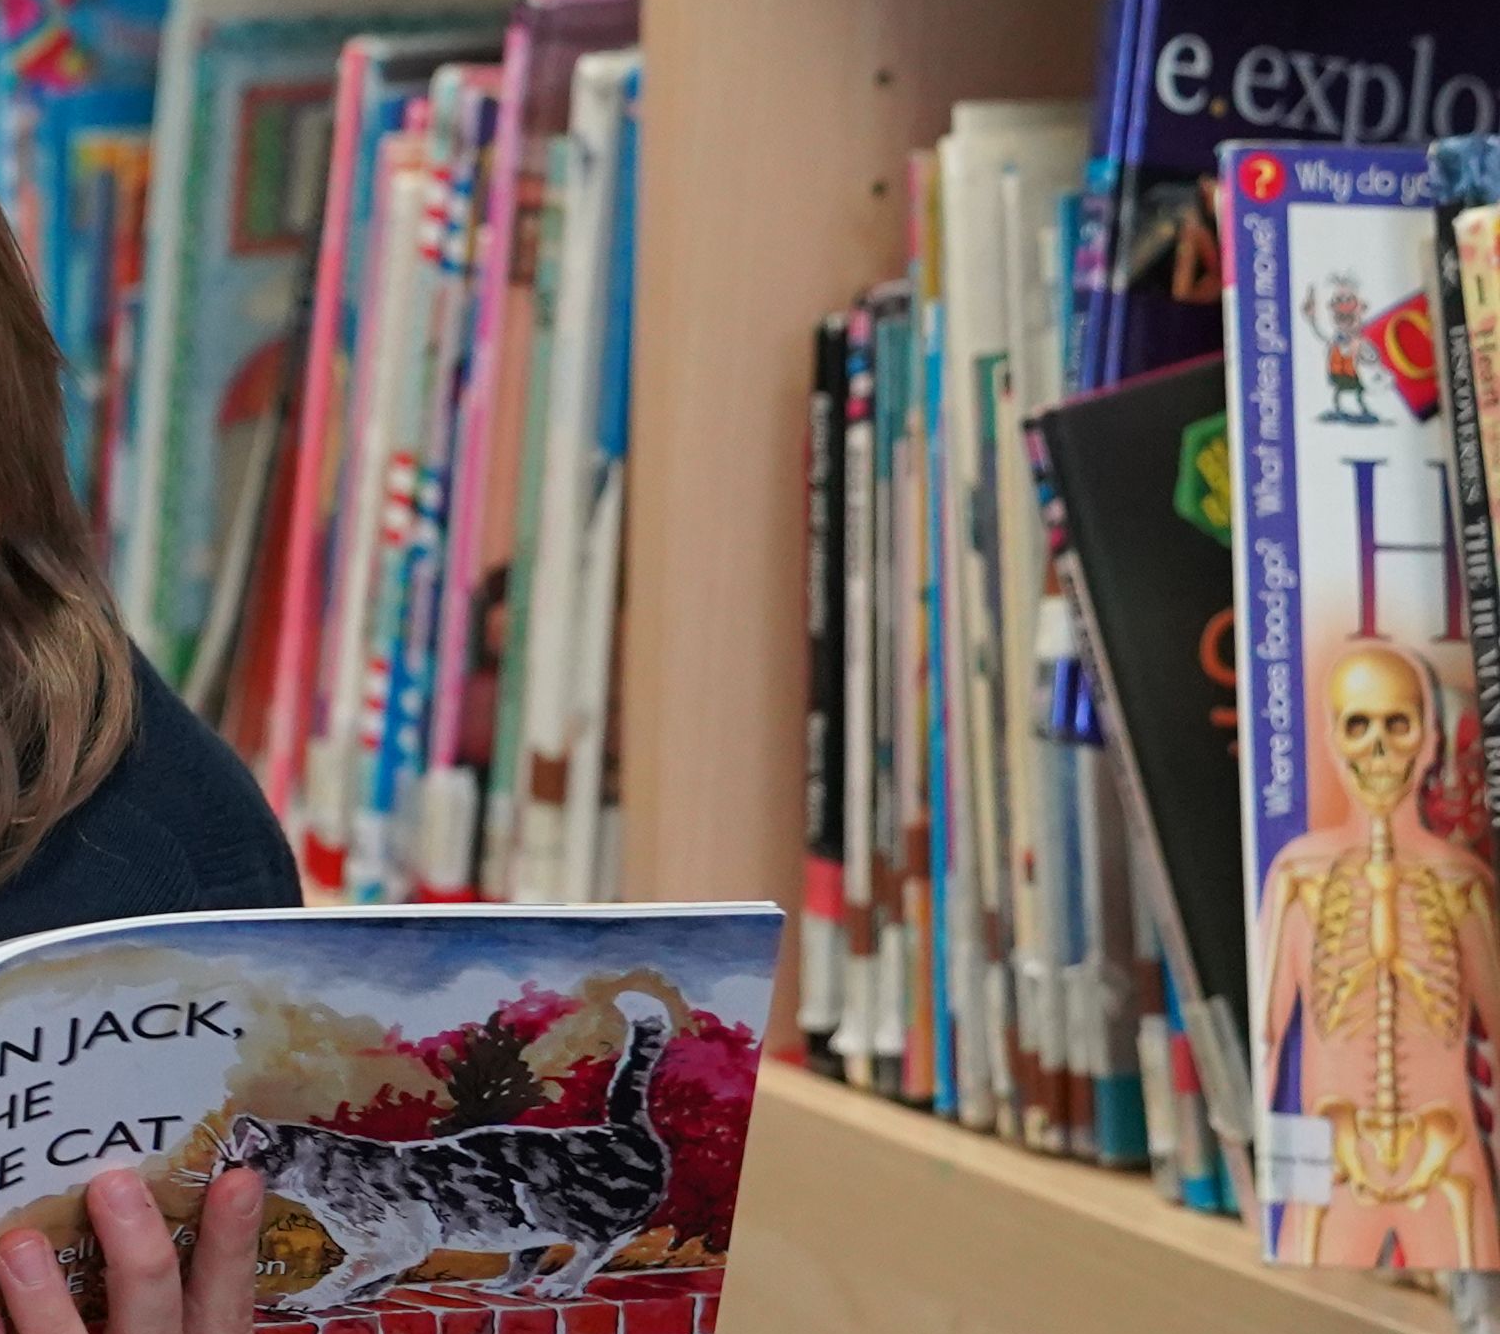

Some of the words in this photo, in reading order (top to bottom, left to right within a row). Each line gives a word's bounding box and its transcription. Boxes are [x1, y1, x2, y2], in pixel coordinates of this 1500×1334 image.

[1295, 159, 1351, 204] Why
[1357, 162, 1397, 197] do
[1401, 170, 1435, 206] yo
[1244, 213, 1277, 298] move?
[1255, 298, 1287, 354] you
[1249, 355, 1282, 441] makes
[1253, 444, 1284, 517] What
[1255, 537, 1298, 591] go?
[1463, 515, 1493, 592] THE
[1257, 589, 1290, 659] food
[1261, 661, 1292, 733] does
[1263, 733, 1294, 817] Where
[57, 999, 246, 1067] JACK,
[45, 1114, 184, 1167] CAT
